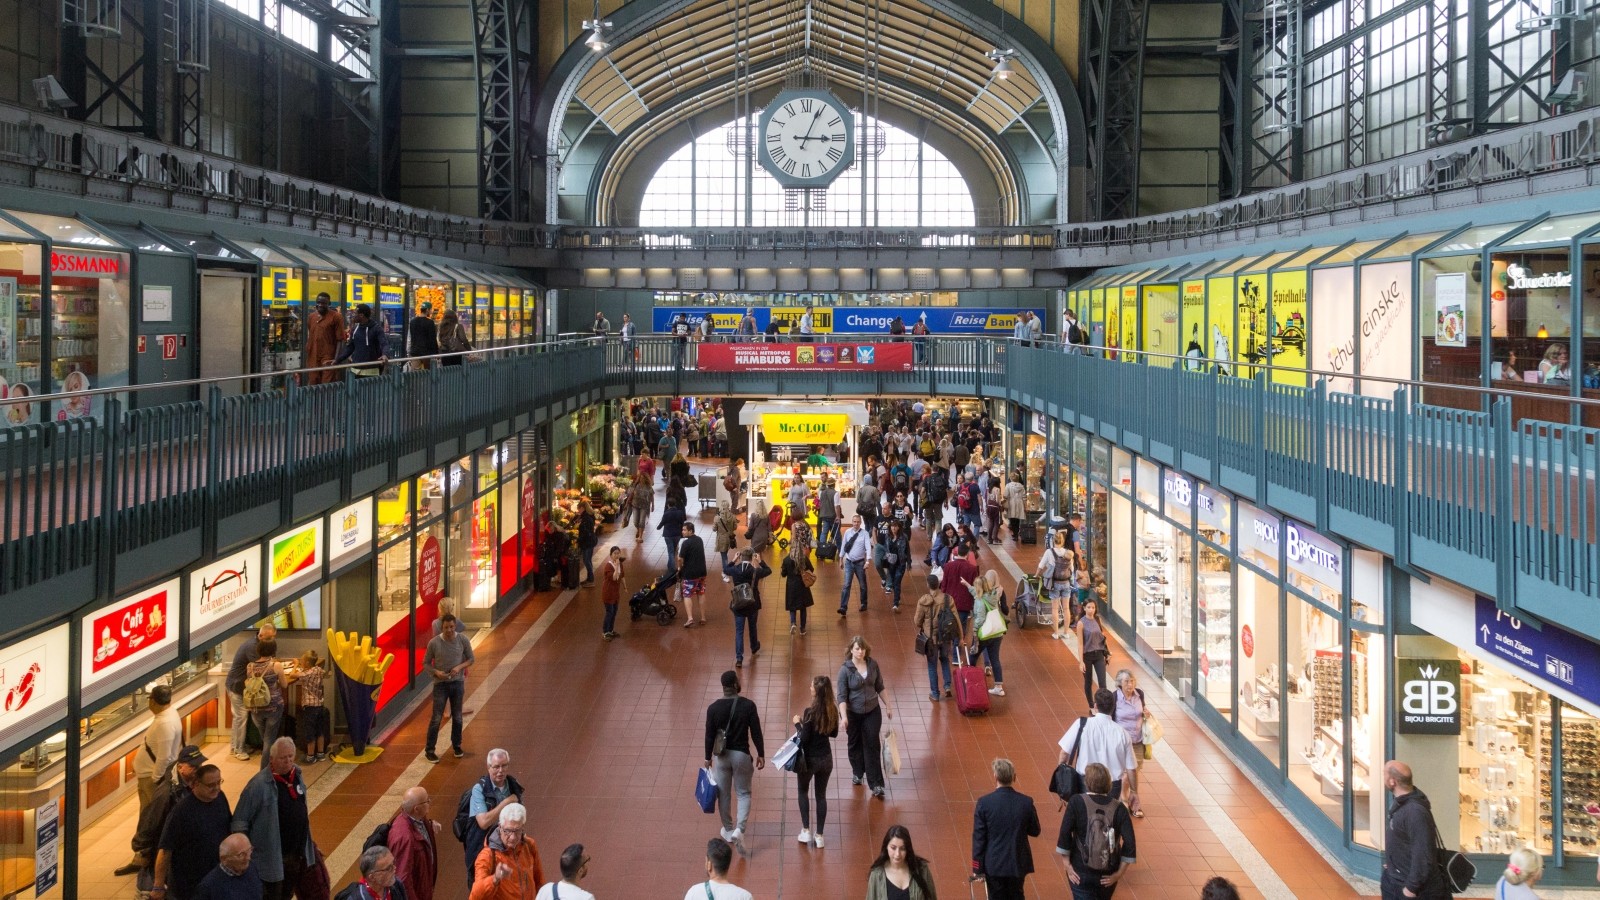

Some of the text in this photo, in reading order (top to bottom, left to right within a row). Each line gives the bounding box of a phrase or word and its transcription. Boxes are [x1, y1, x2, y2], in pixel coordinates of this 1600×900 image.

[800, 99, 813, 113] XII
[51, 251, 119, 273] OSSMANN
[672, 313, 737, 326] Rise ank
[773, 313, 821, 321] WESTN
[846, 314, 893, 329] Change
[954, 313, 987, 325] Reise
[779, 423, 831, 433] Mr. CLOU
[1253, 519, 1337, 571] BIJOU BRIGITTE
[275, 549, 295, 579] WURST
[200, 585, 248, 615] GOURMET-STATION
[121, 606, 144, 638] Café
[1495, 632, 1533, 655] zu den Zügen
